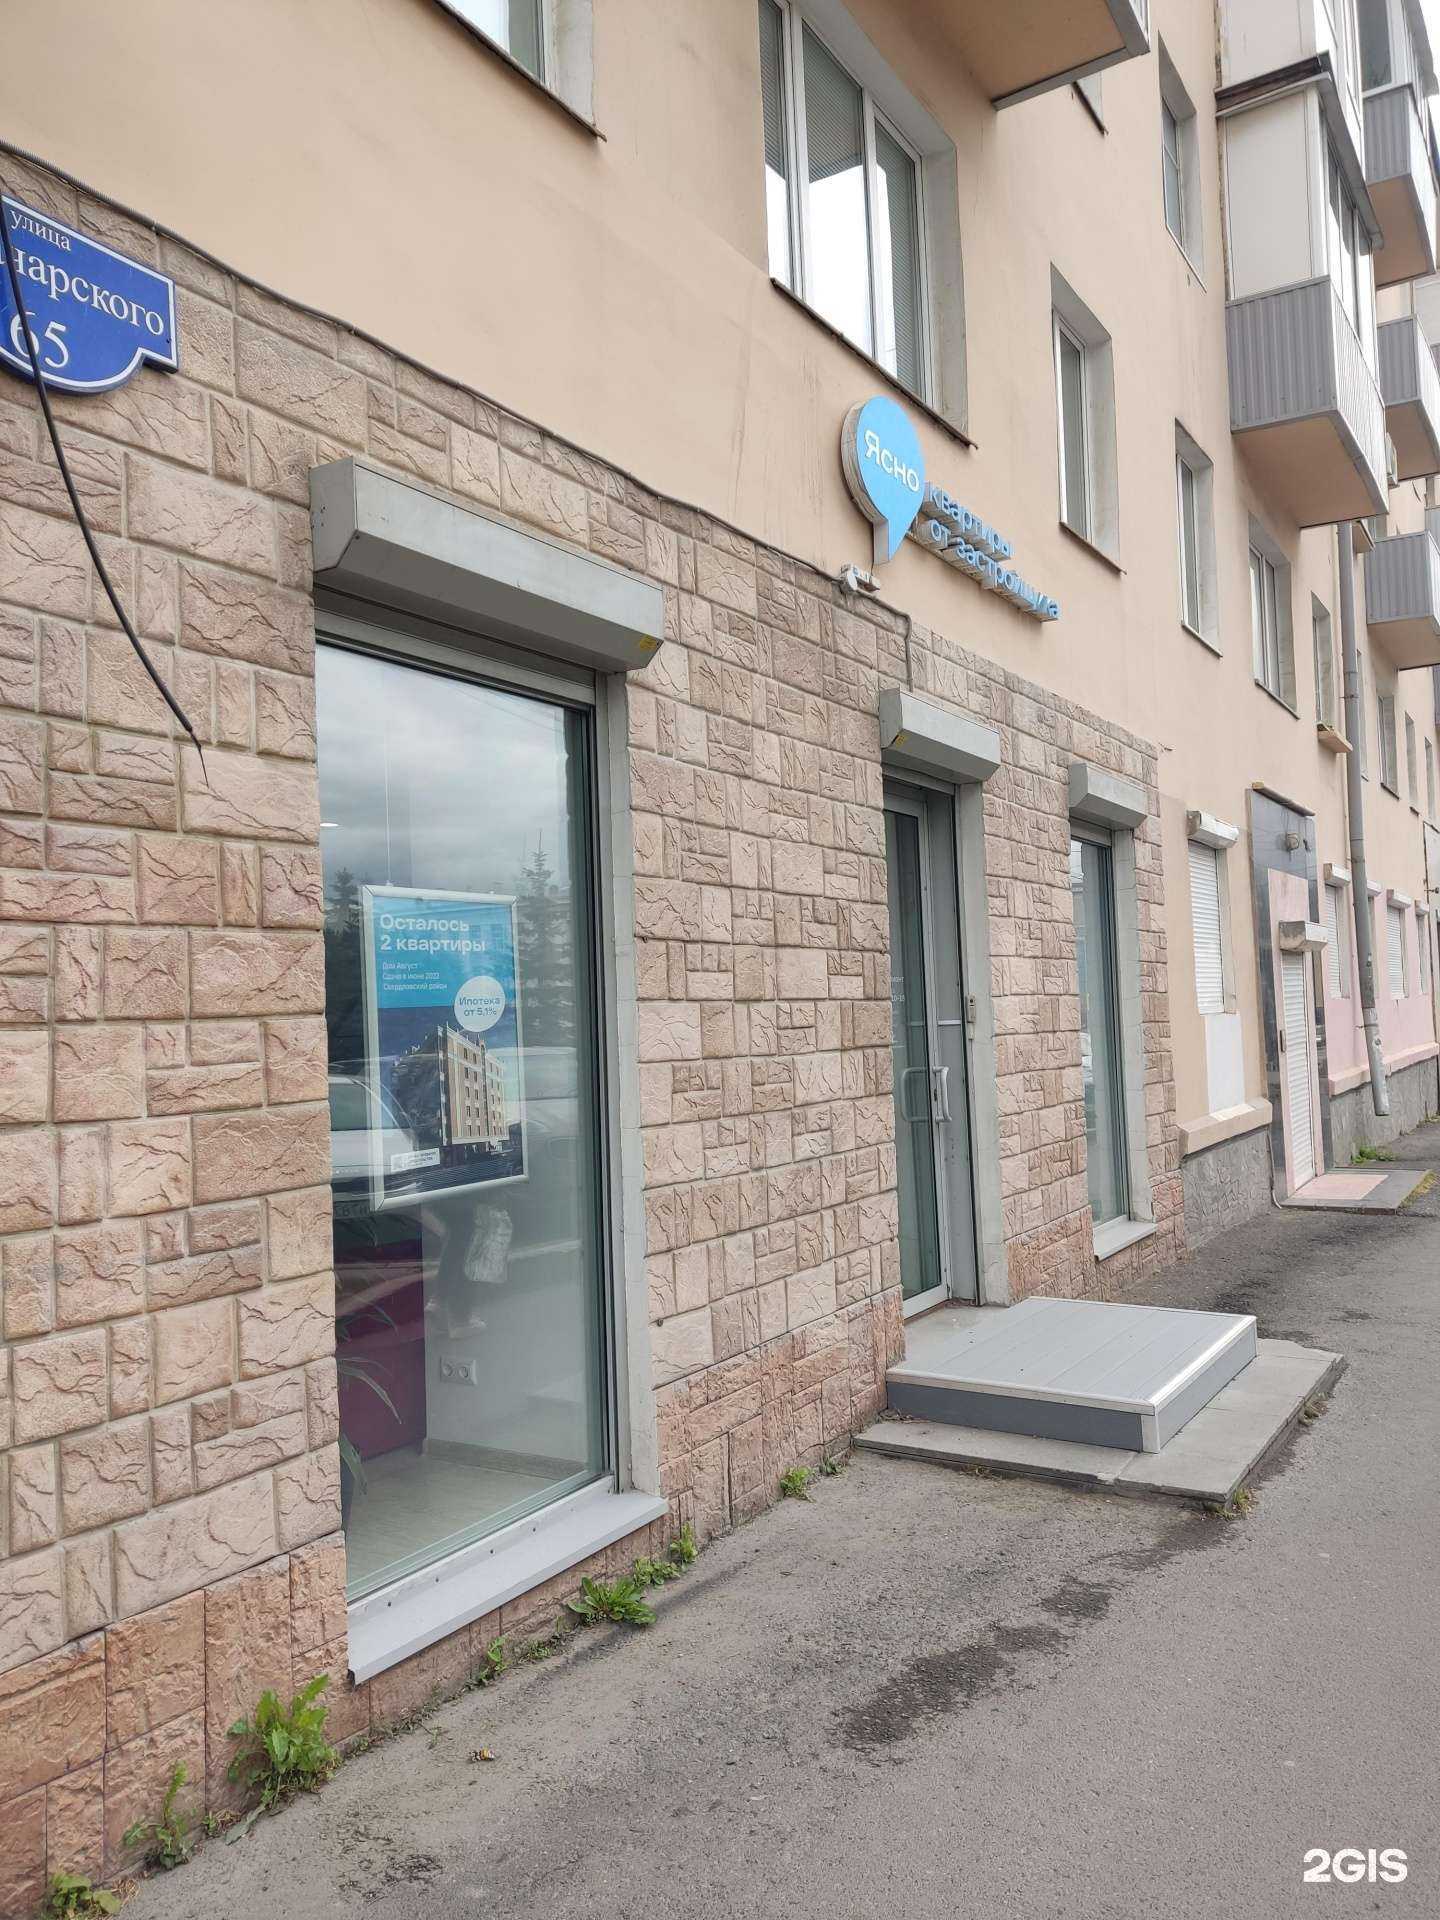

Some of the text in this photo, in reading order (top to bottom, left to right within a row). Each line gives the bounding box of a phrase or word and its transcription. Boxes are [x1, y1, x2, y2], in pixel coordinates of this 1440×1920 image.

[10, 209, 72, 252] улица
[10, 311, 69, 369] 65
[864, 429, 920, 492] Ясно
[380, 913, 470, 932] Осталось
[380, 934, 486, 955] 2 квартиры
[459, 996, 501, 1006] Ипотека
[463, 1009, 475, 1017] от
